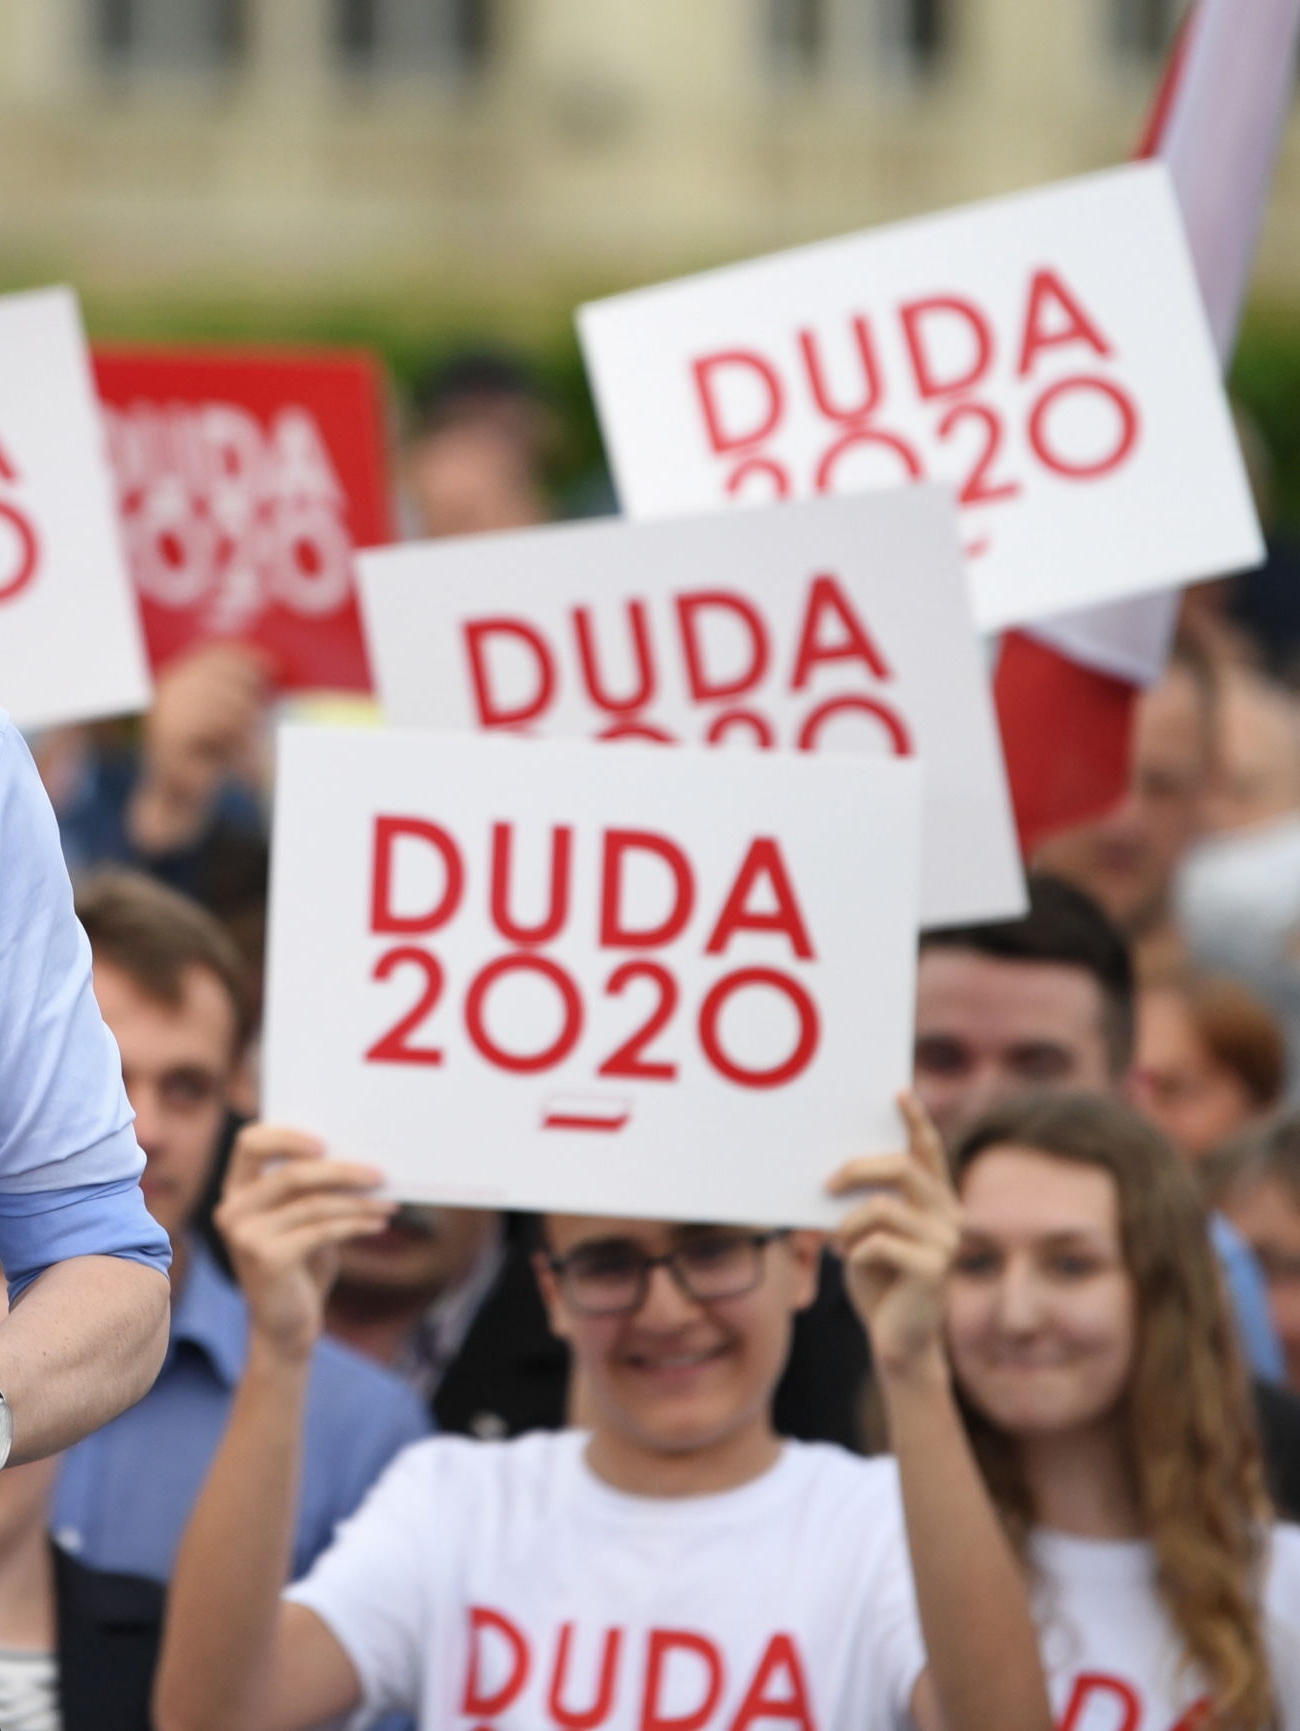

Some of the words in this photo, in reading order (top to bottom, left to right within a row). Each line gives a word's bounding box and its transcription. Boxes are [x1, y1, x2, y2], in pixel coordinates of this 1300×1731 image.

[691, 267, 1113, 456] DUDA
[117, 485, 355, 613] 020
[461, 571, 895, 731] DUDA
[368, 813, 818, 963] DUDA
[362, 944, 820, 1091] 2020
[462, 1604, 818, 1731] DUDA
